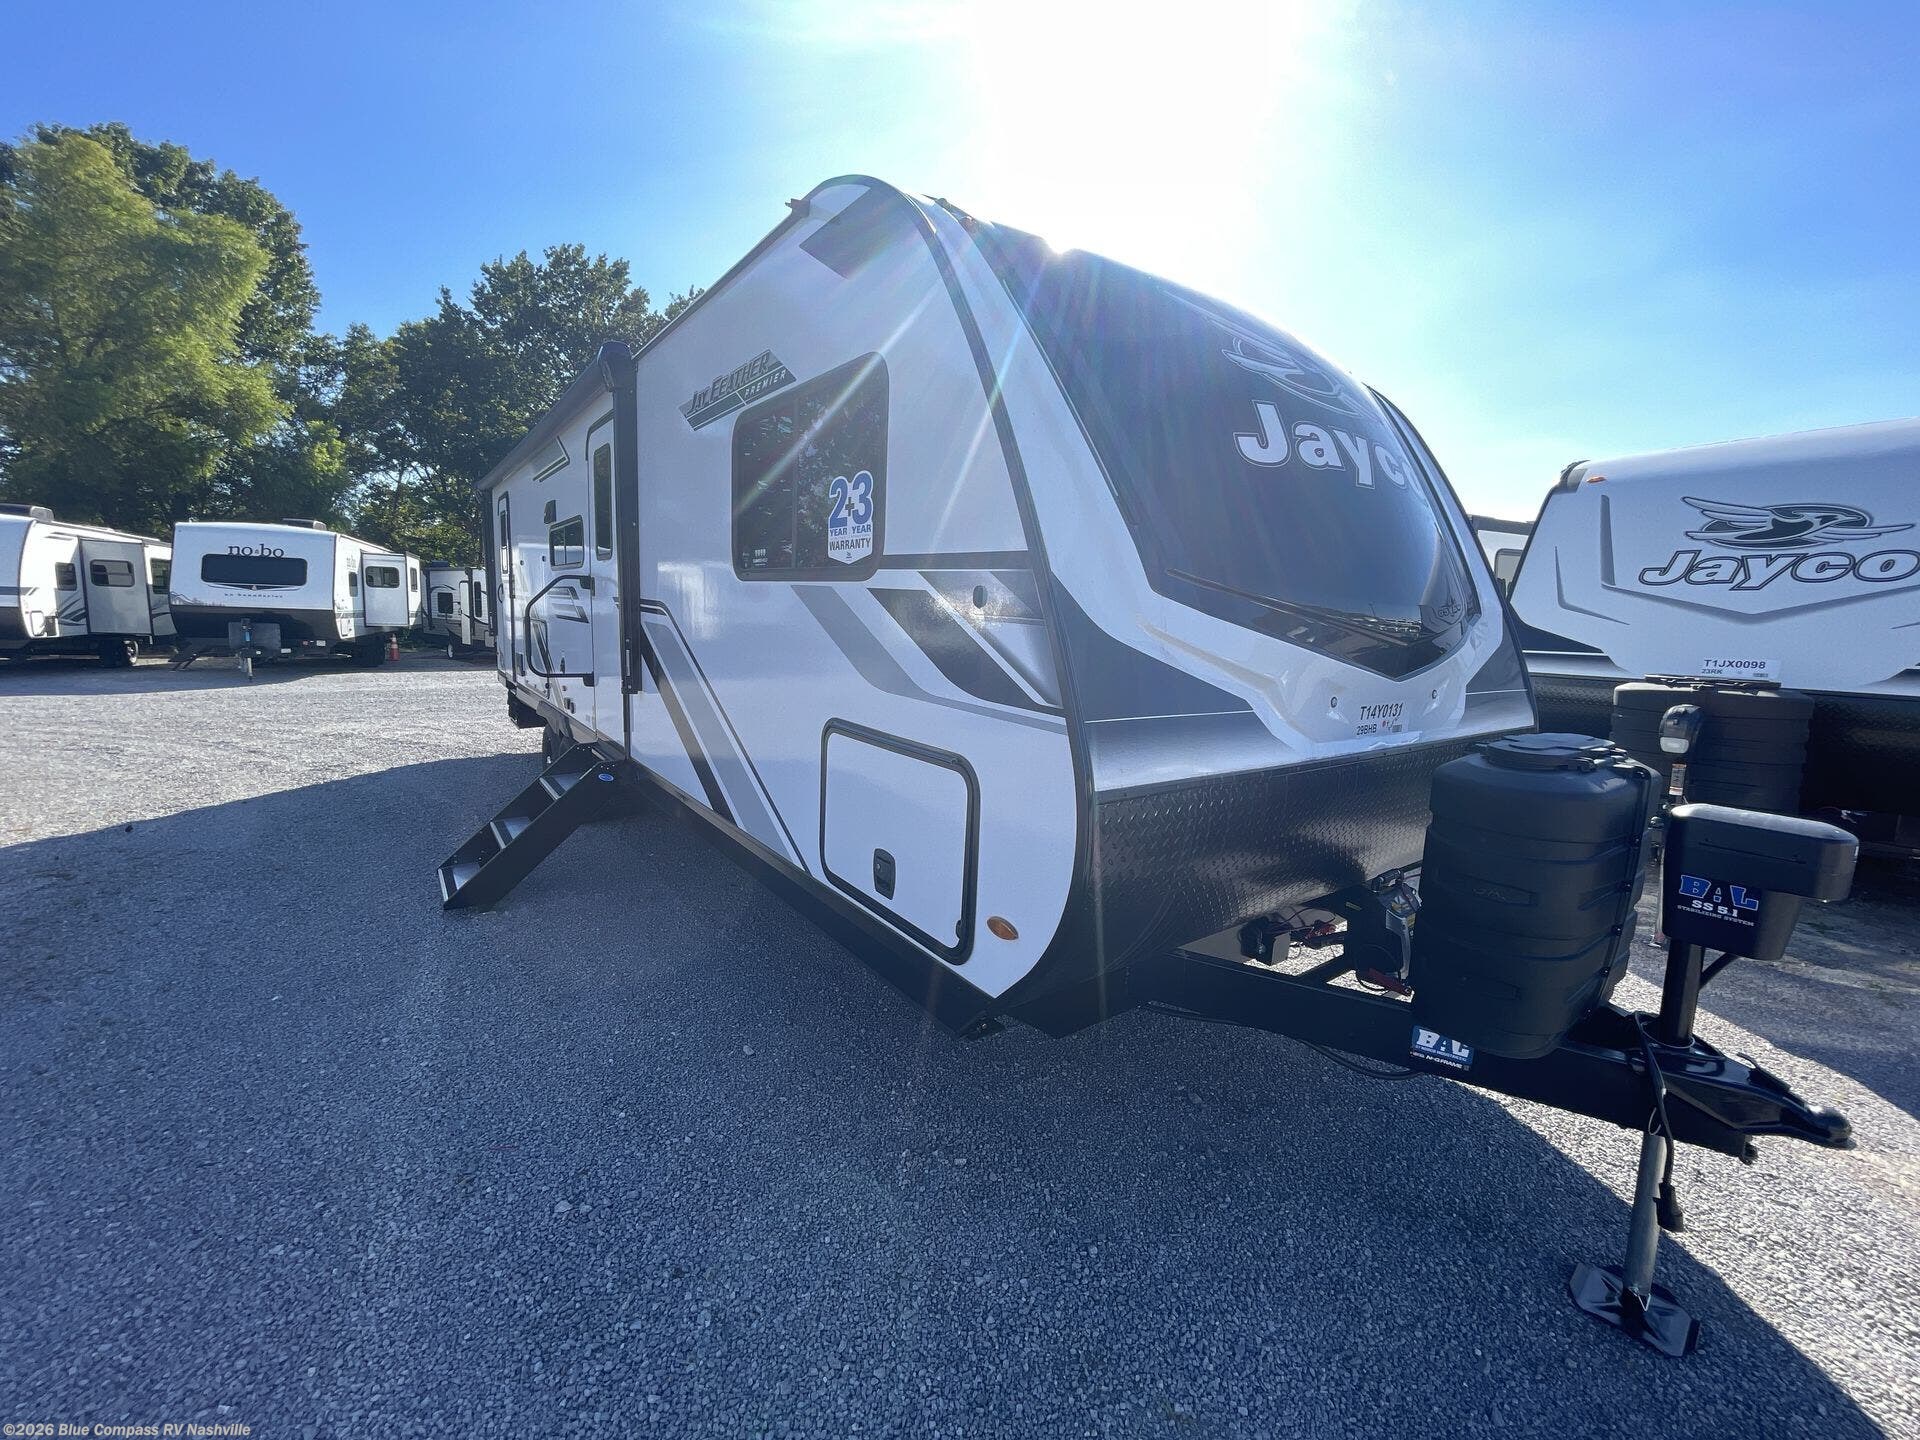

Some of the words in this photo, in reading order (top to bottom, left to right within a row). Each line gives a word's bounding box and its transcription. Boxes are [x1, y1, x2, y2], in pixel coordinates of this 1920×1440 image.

[744, 368, 787, 399] PREMIER
[829, 527, 848, 537] YEAR
[852, 524, 872, 534] YEAR
[829, 537, 872, 552] WARRANTY
[1638, 549, 1920, 591] Jayco
[1703, 659, 1767, 670] T1JX0098
[1360, 702, 1404, 721] T14Y0131
[1356, 723, 1378, 736] 29BHB
[1678, 874, 1760, 912] BAL
[1692, 899, 1714, 911] SS
[1416, 1028, 1470, 1058] BAL
